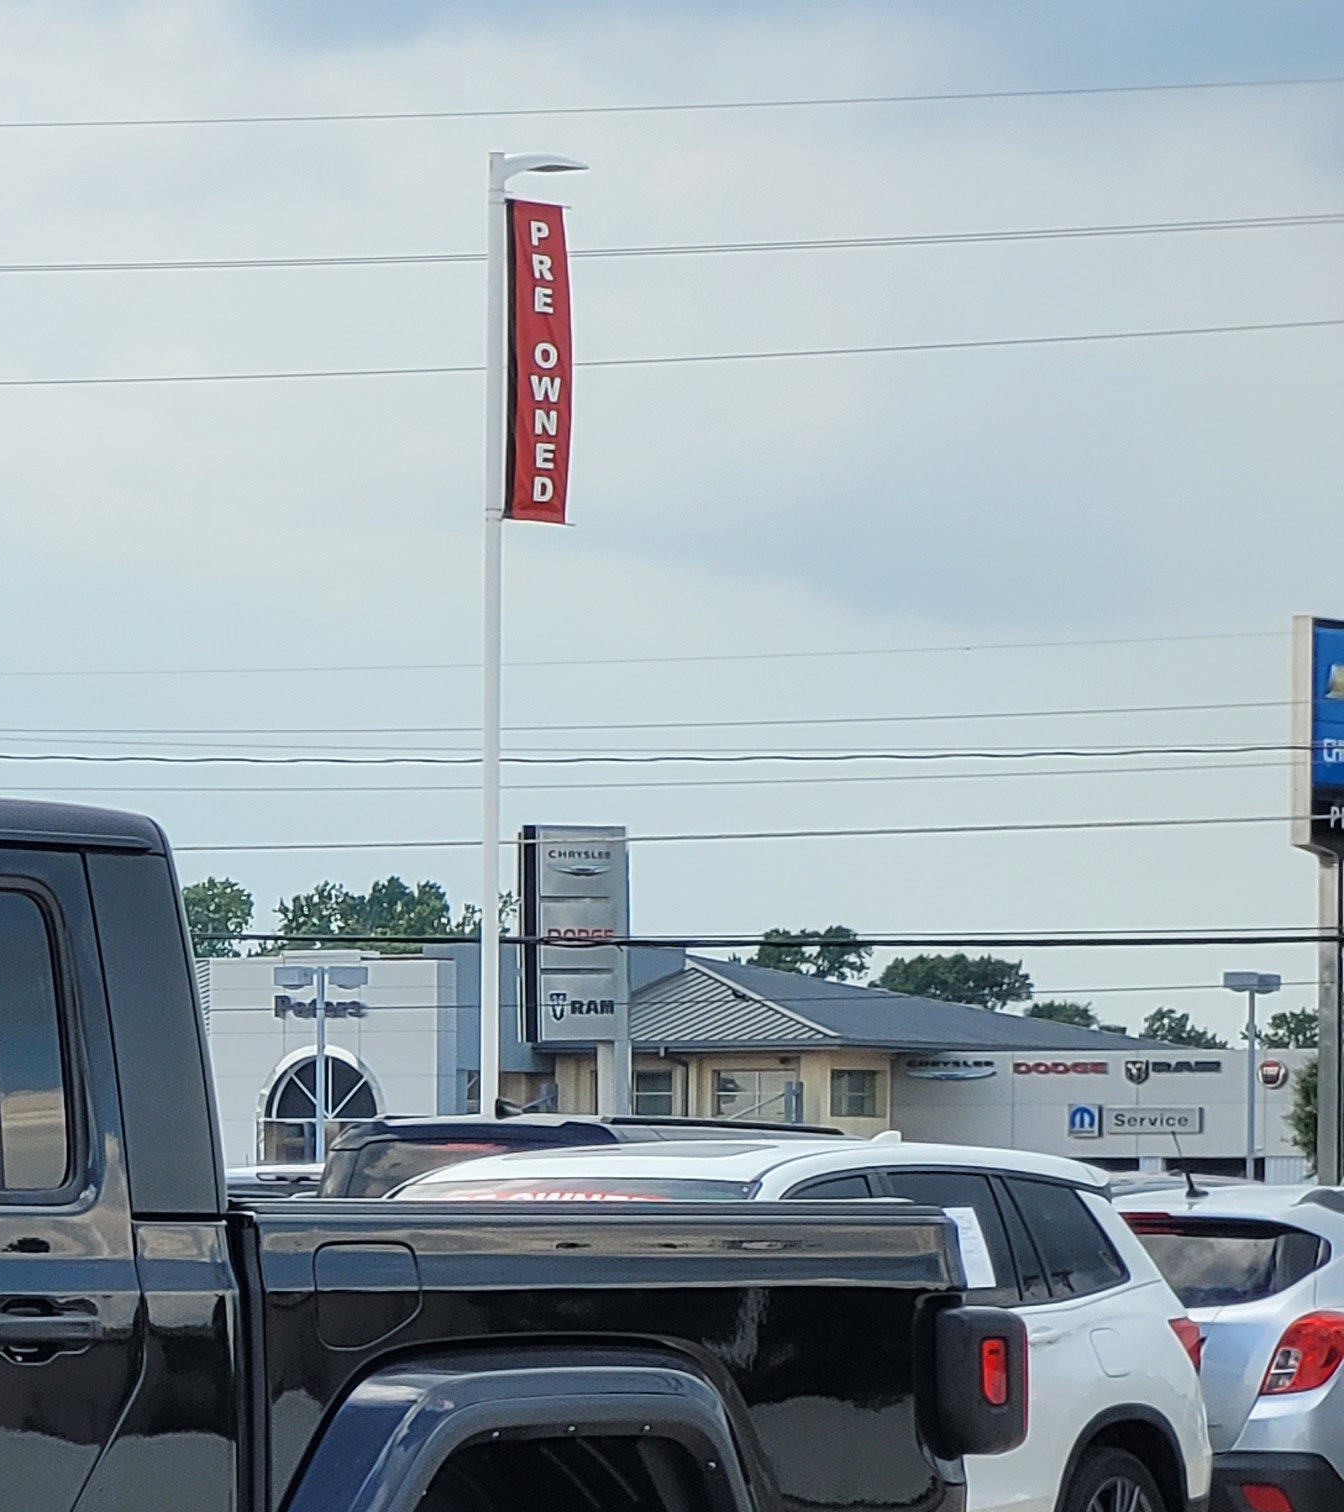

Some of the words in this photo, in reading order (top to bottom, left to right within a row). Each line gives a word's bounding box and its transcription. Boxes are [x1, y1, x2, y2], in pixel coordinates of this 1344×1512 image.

[529, 219, 554, 315] PRE
[529, 341, 562, 503] OWNED
[570, 1000, 615, 1015] RAM
[1013, 1062, 1109, 1075] DODGE
[1114, 1113, 1189, 1127] Service
